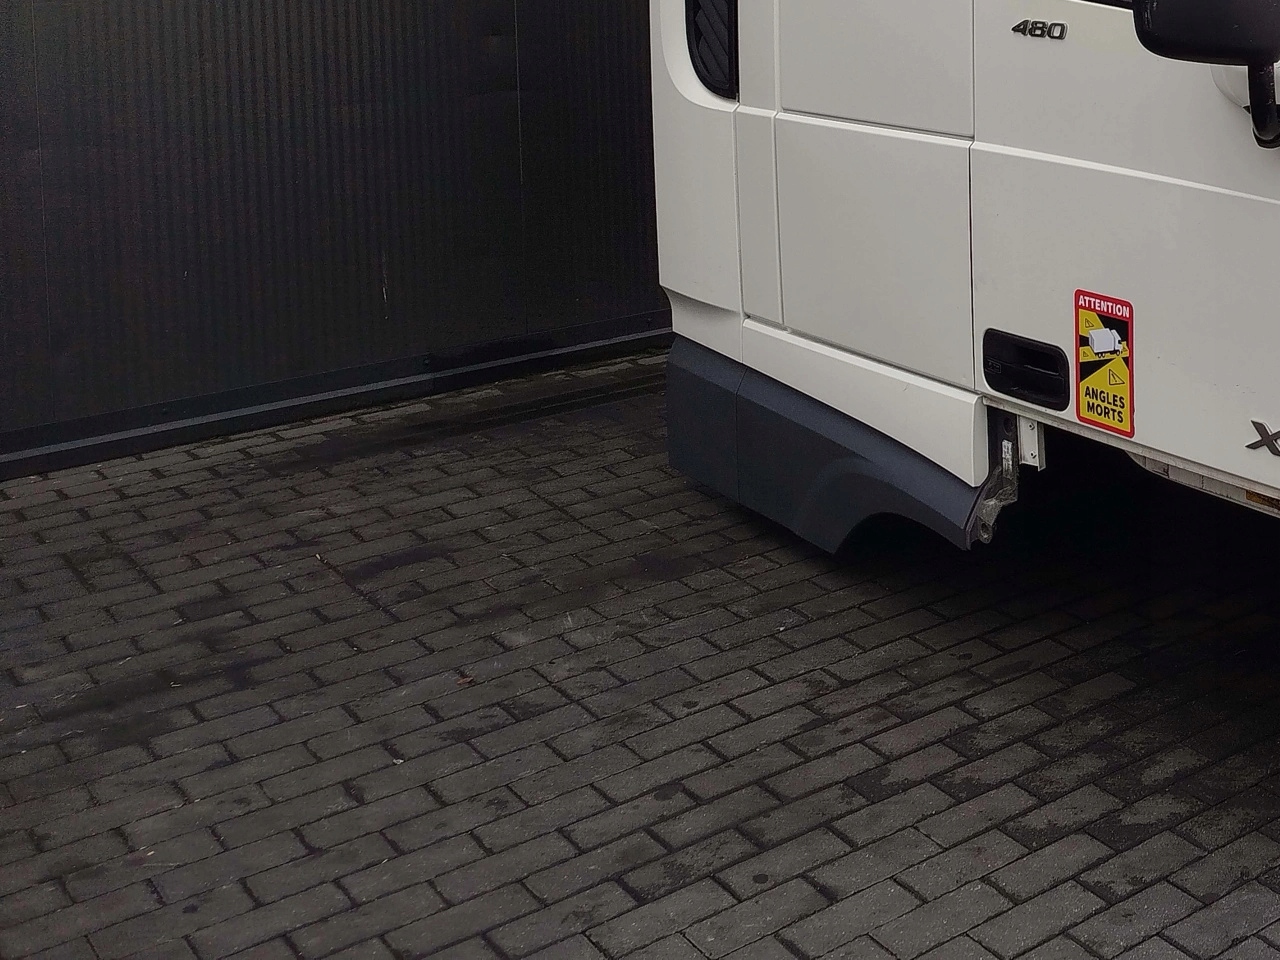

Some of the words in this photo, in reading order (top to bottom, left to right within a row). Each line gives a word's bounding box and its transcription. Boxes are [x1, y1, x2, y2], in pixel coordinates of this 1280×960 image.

[1011, 19, 1068, 40] 480
[1079, 295, 1130, 318] ATTENTION
[1084, 386, 1126, 409] ANGLES
[1086, 401, 1124, 424] MORTS
